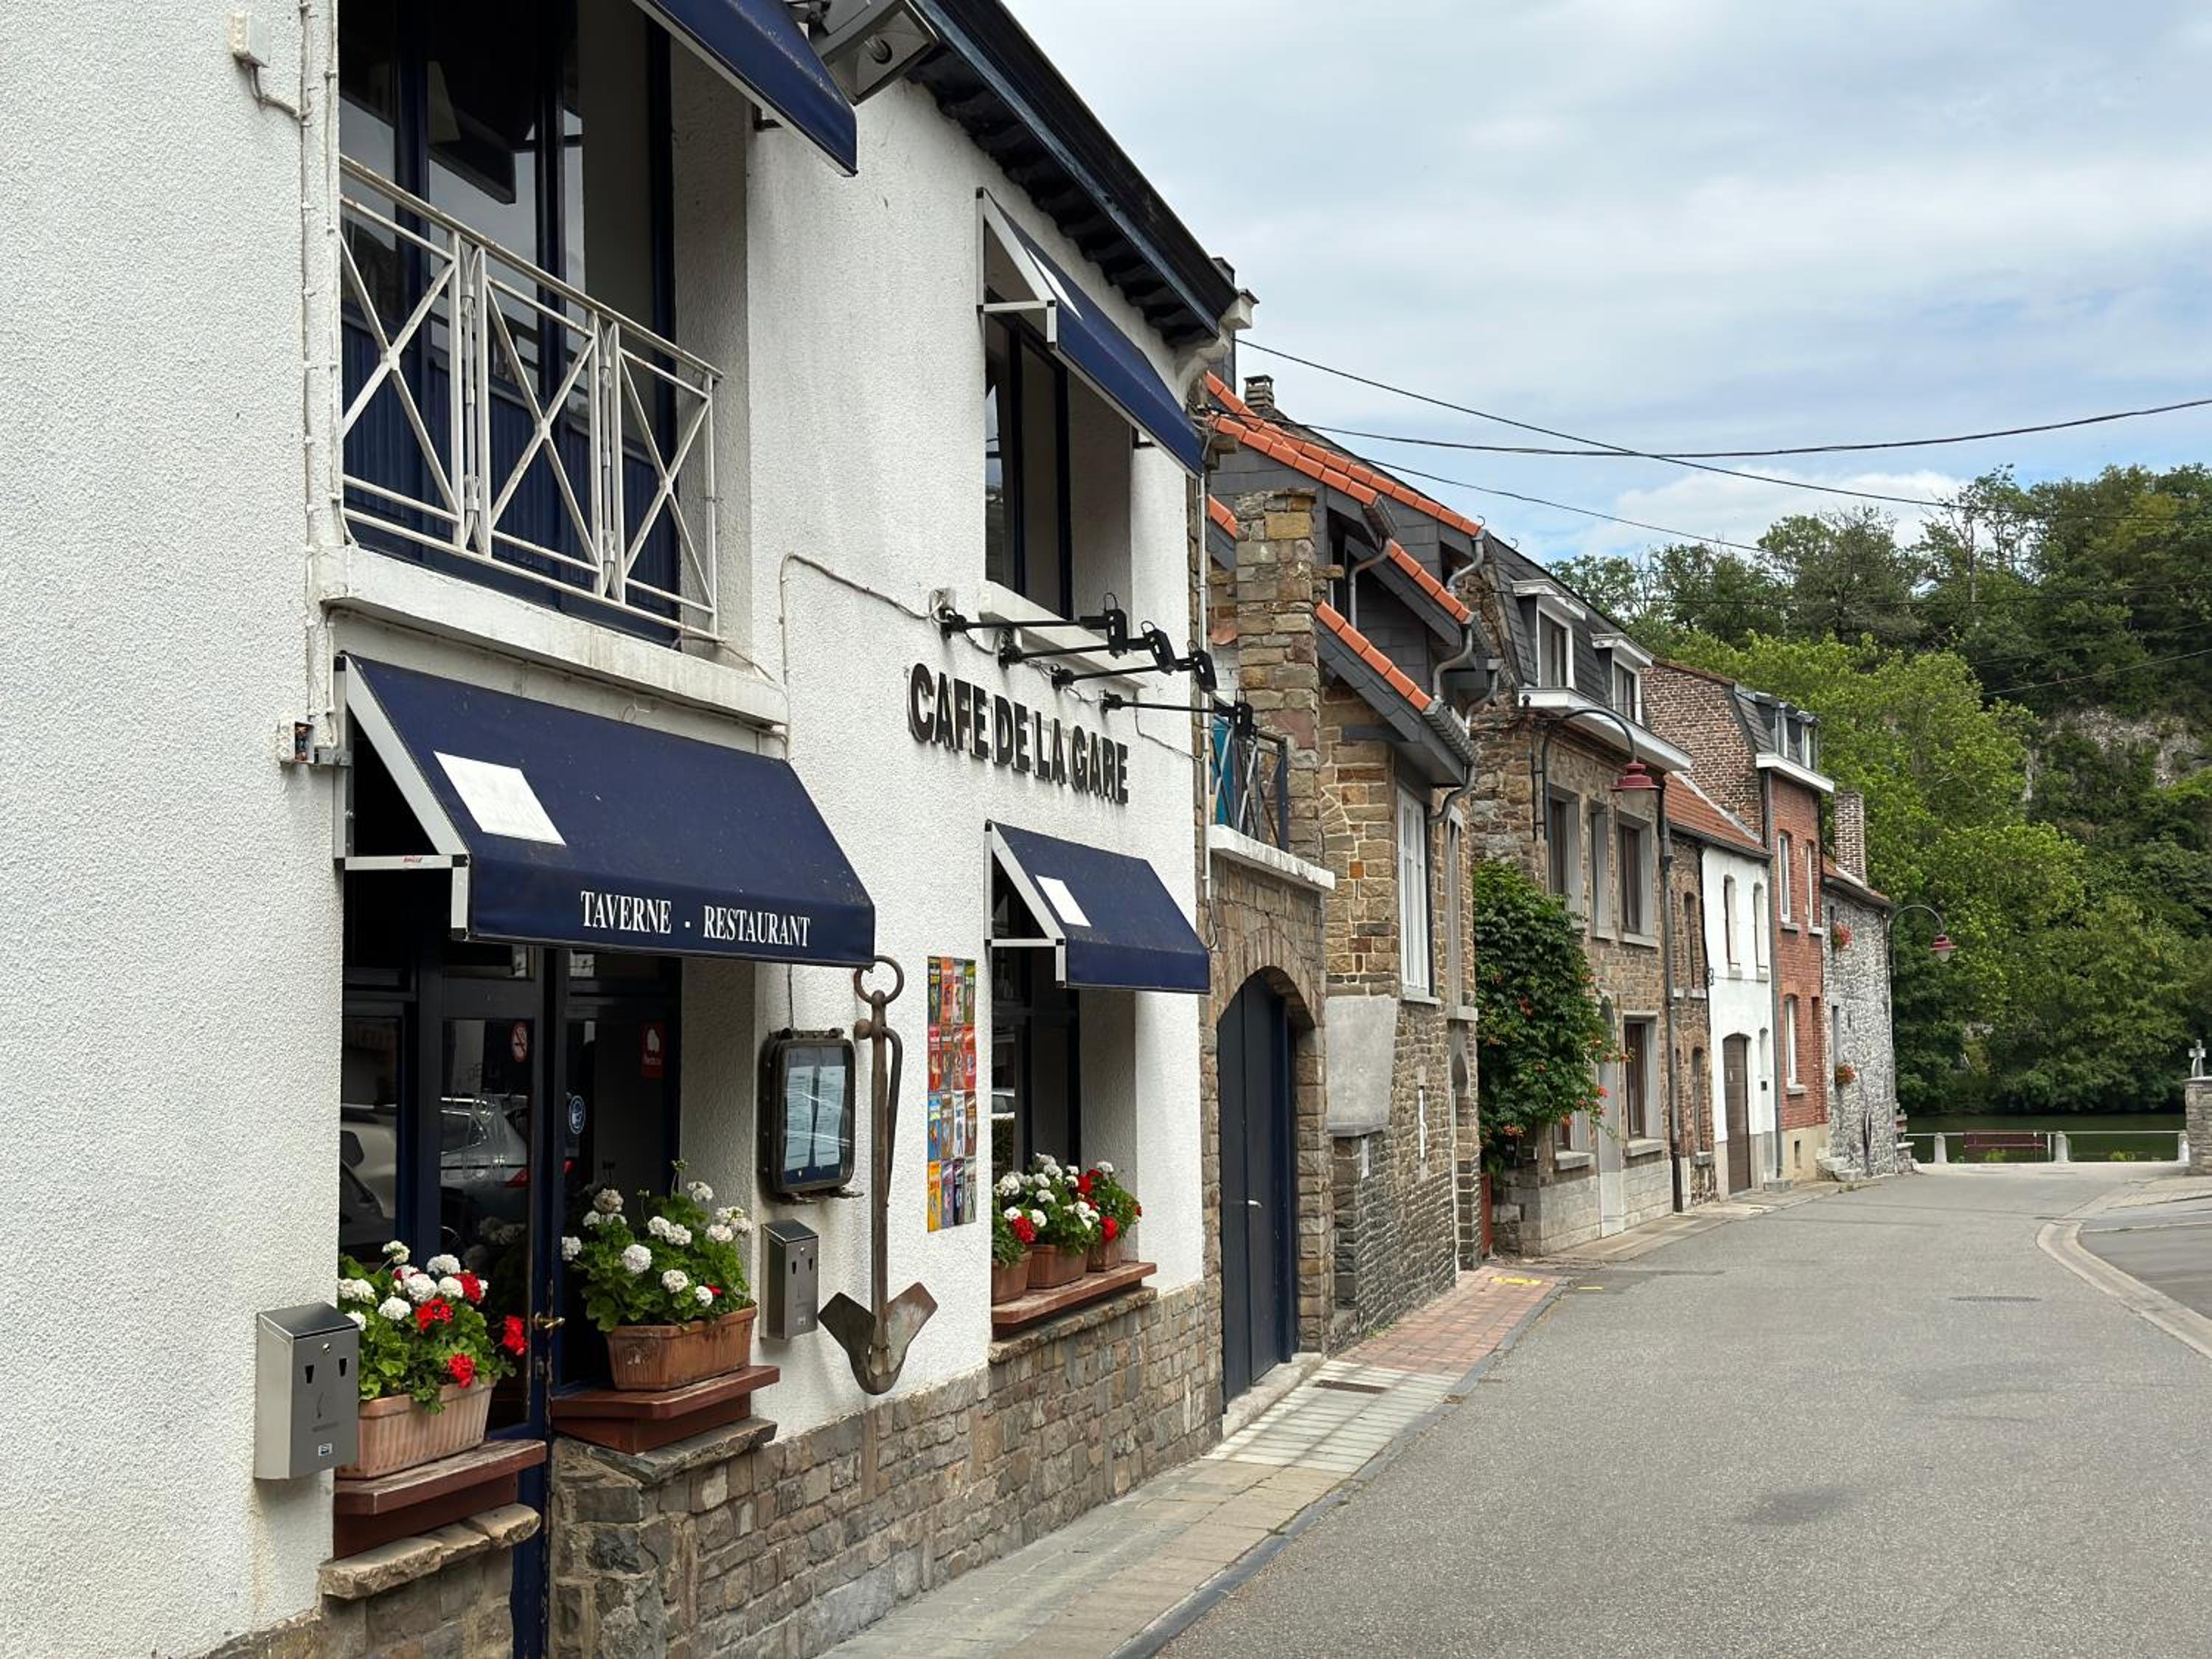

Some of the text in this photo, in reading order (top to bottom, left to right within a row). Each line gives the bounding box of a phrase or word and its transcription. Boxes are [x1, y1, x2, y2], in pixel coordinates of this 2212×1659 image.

[908, 663, 1130, 804] CAFE DE LA GARE
[580, 890, 810, 948] TAVERNE RESTAURANT
